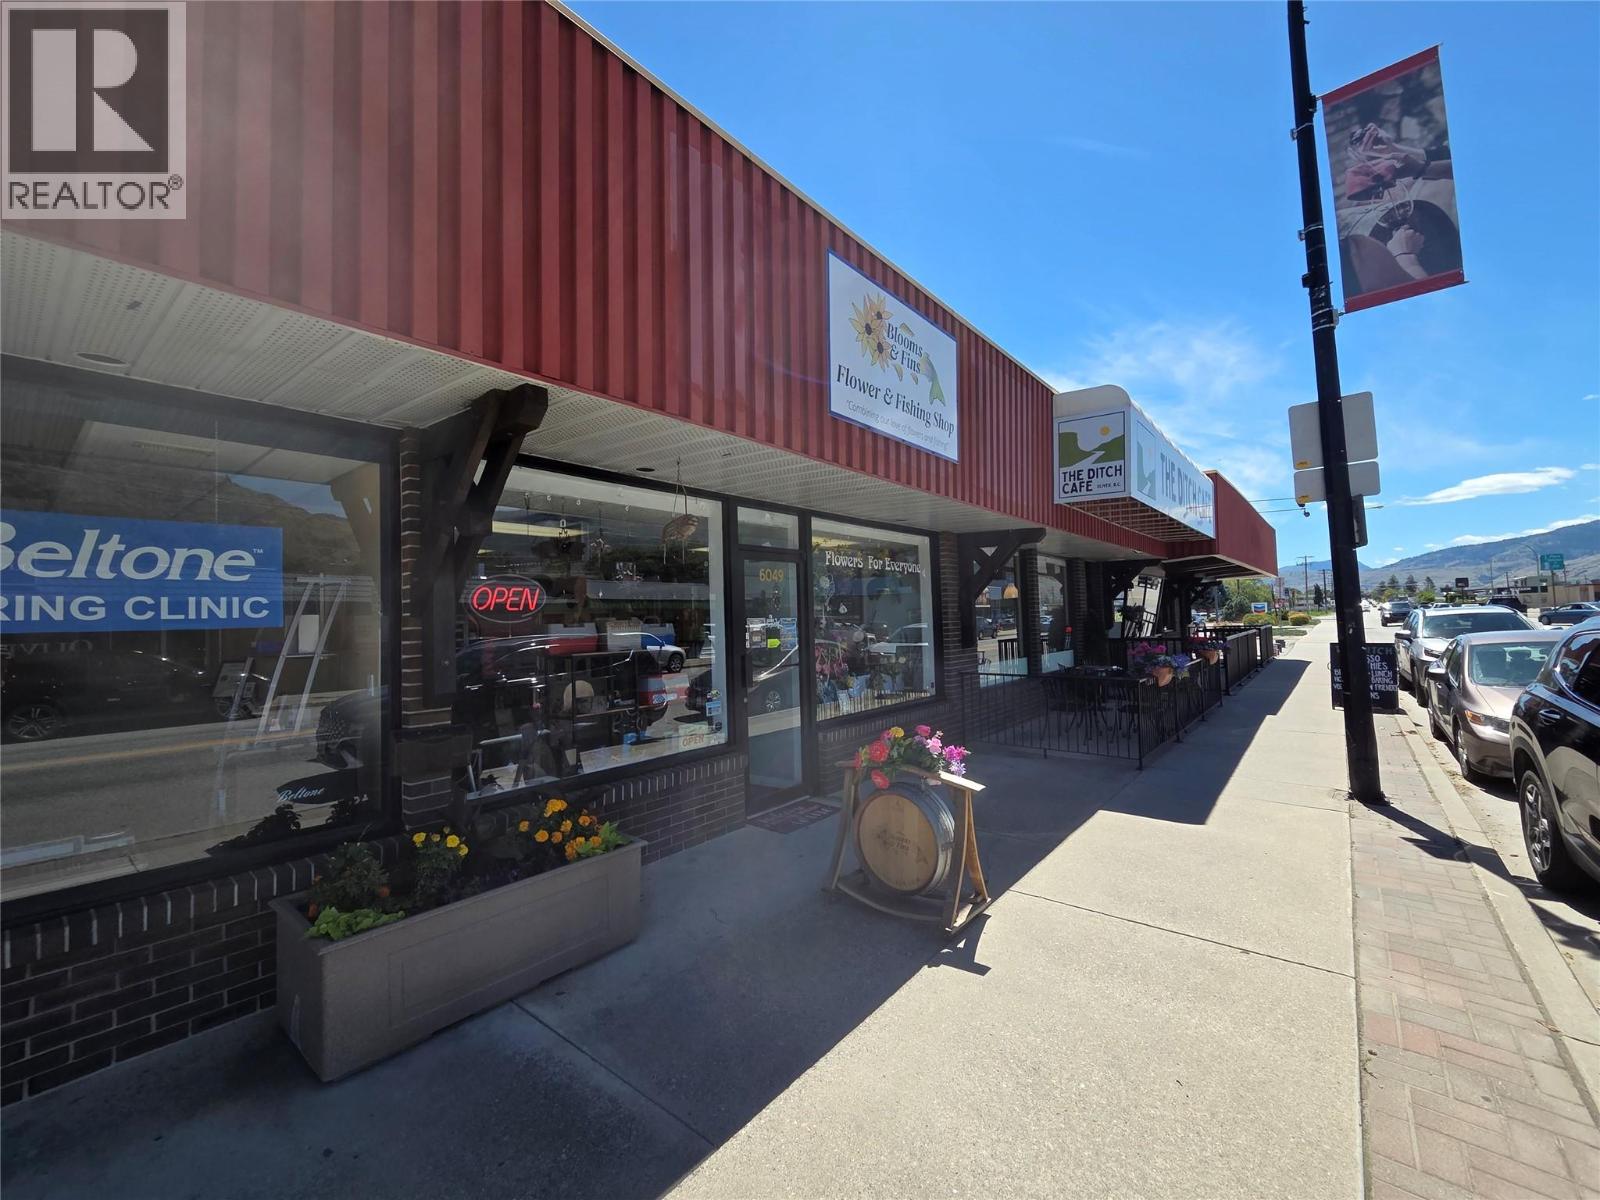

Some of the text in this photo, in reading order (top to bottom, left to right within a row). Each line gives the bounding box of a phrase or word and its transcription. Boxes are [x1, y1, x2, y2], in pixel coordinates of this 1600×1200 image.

[887, 322, 923, 358] Blooms
[890, 344, 921, 374] & Fins
[837, 364, 955, 438] Flower & Fishing Shop
[1062, 464, 1123, 482] THE DITCH
[1160, 452, 1176, 502] THE
[1062, 480, 1093, 494] CAFE
[825, 550, 921, 574] Flowers For Everyone
[760, 568, 785, 582] 6049
[124, 596, 270, 620] CLINIC
[472, 586, 540, 611] OPEN
[682, 733, 705, 747] OPEN
[277, 786, 326, 802] Beltone
